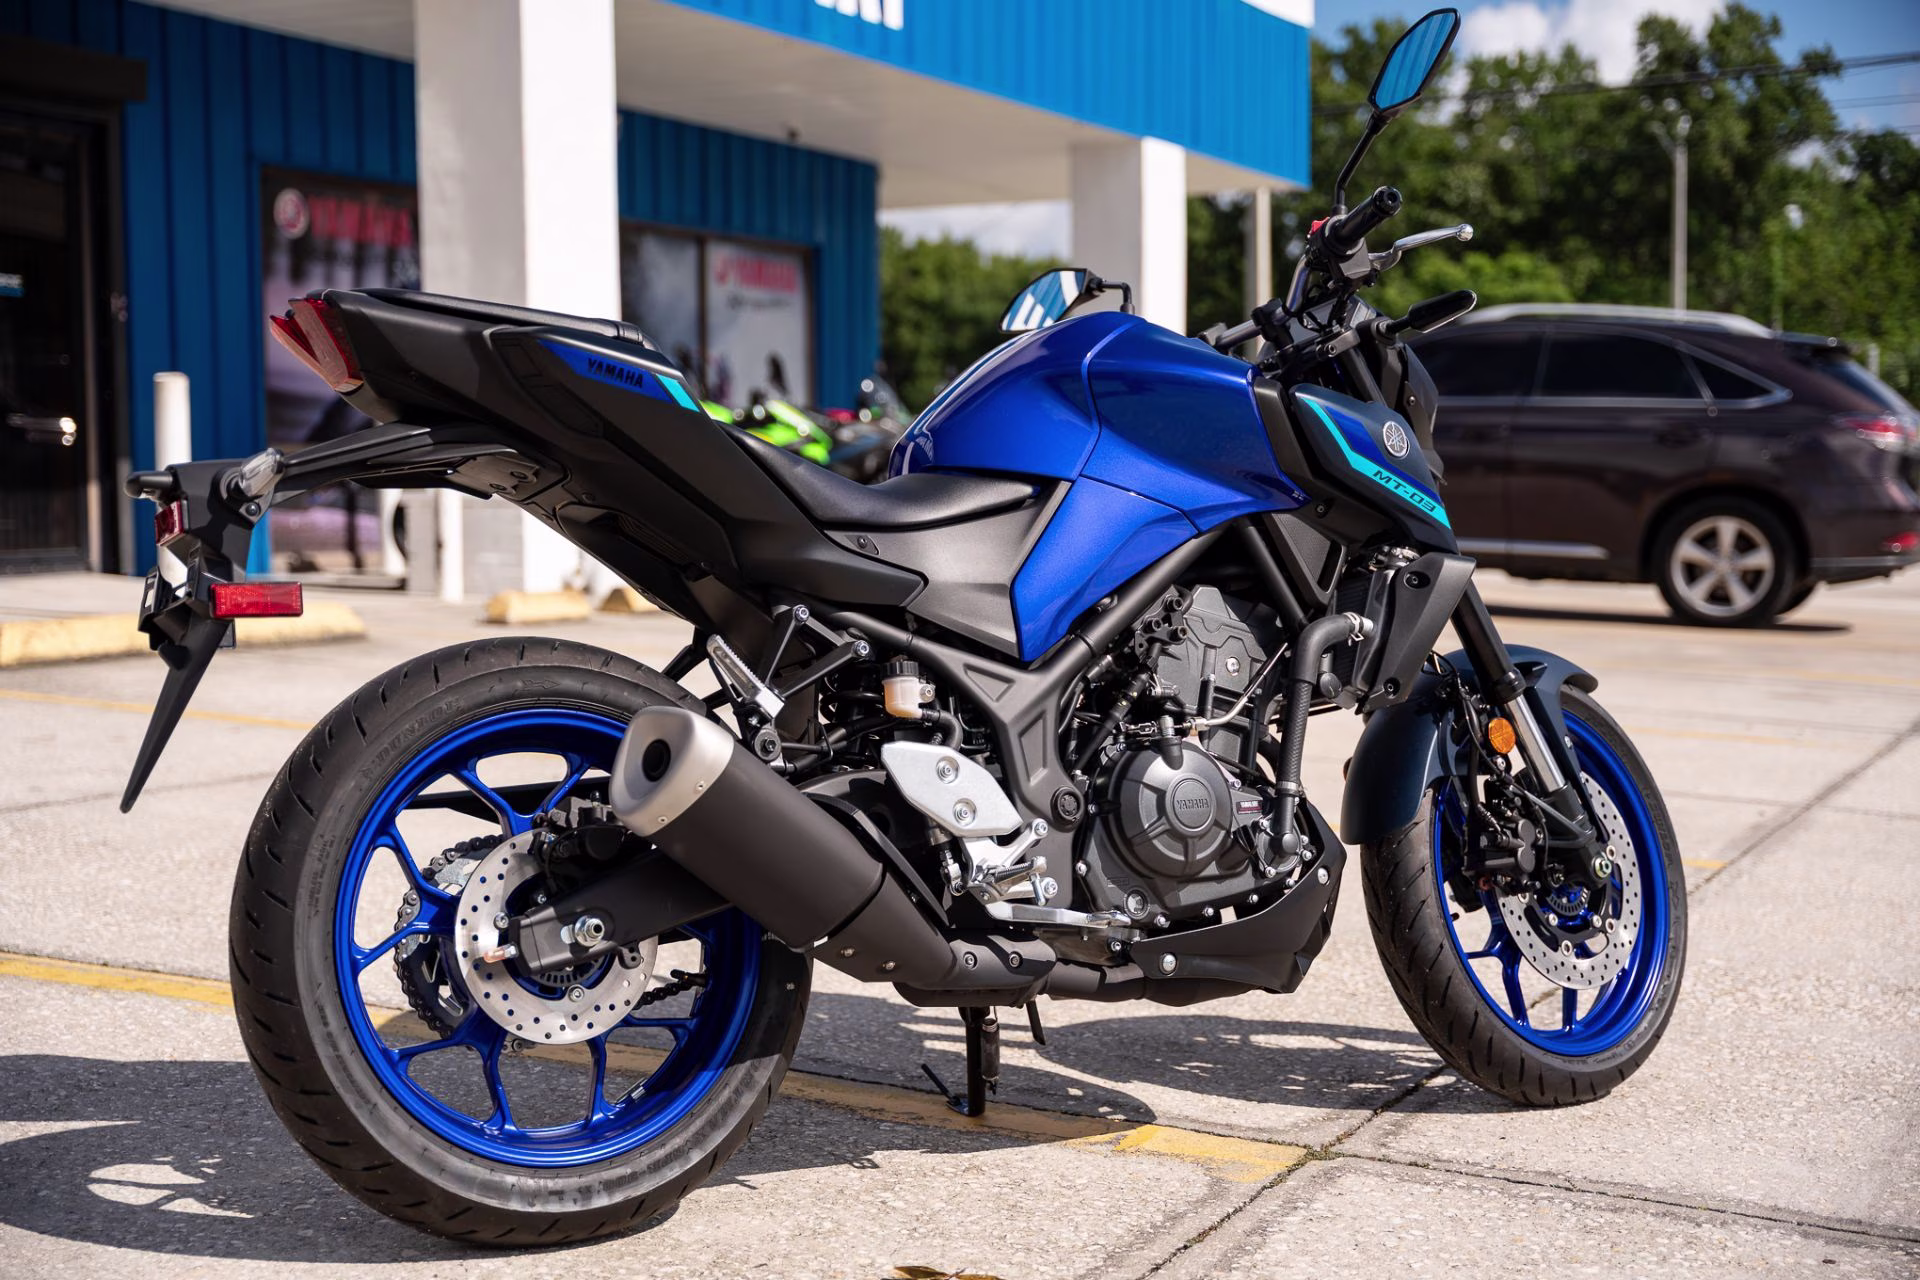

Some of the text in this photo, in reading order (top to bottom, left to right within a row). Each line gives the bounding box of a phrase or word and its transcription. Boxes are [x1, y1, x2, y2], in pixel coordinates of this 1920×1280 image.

[587, 357, 643, 389] YAMAHA
[1373, 470, 1437, 513] MT-03
[1176, 798, 1210, 810] YAMAHA
